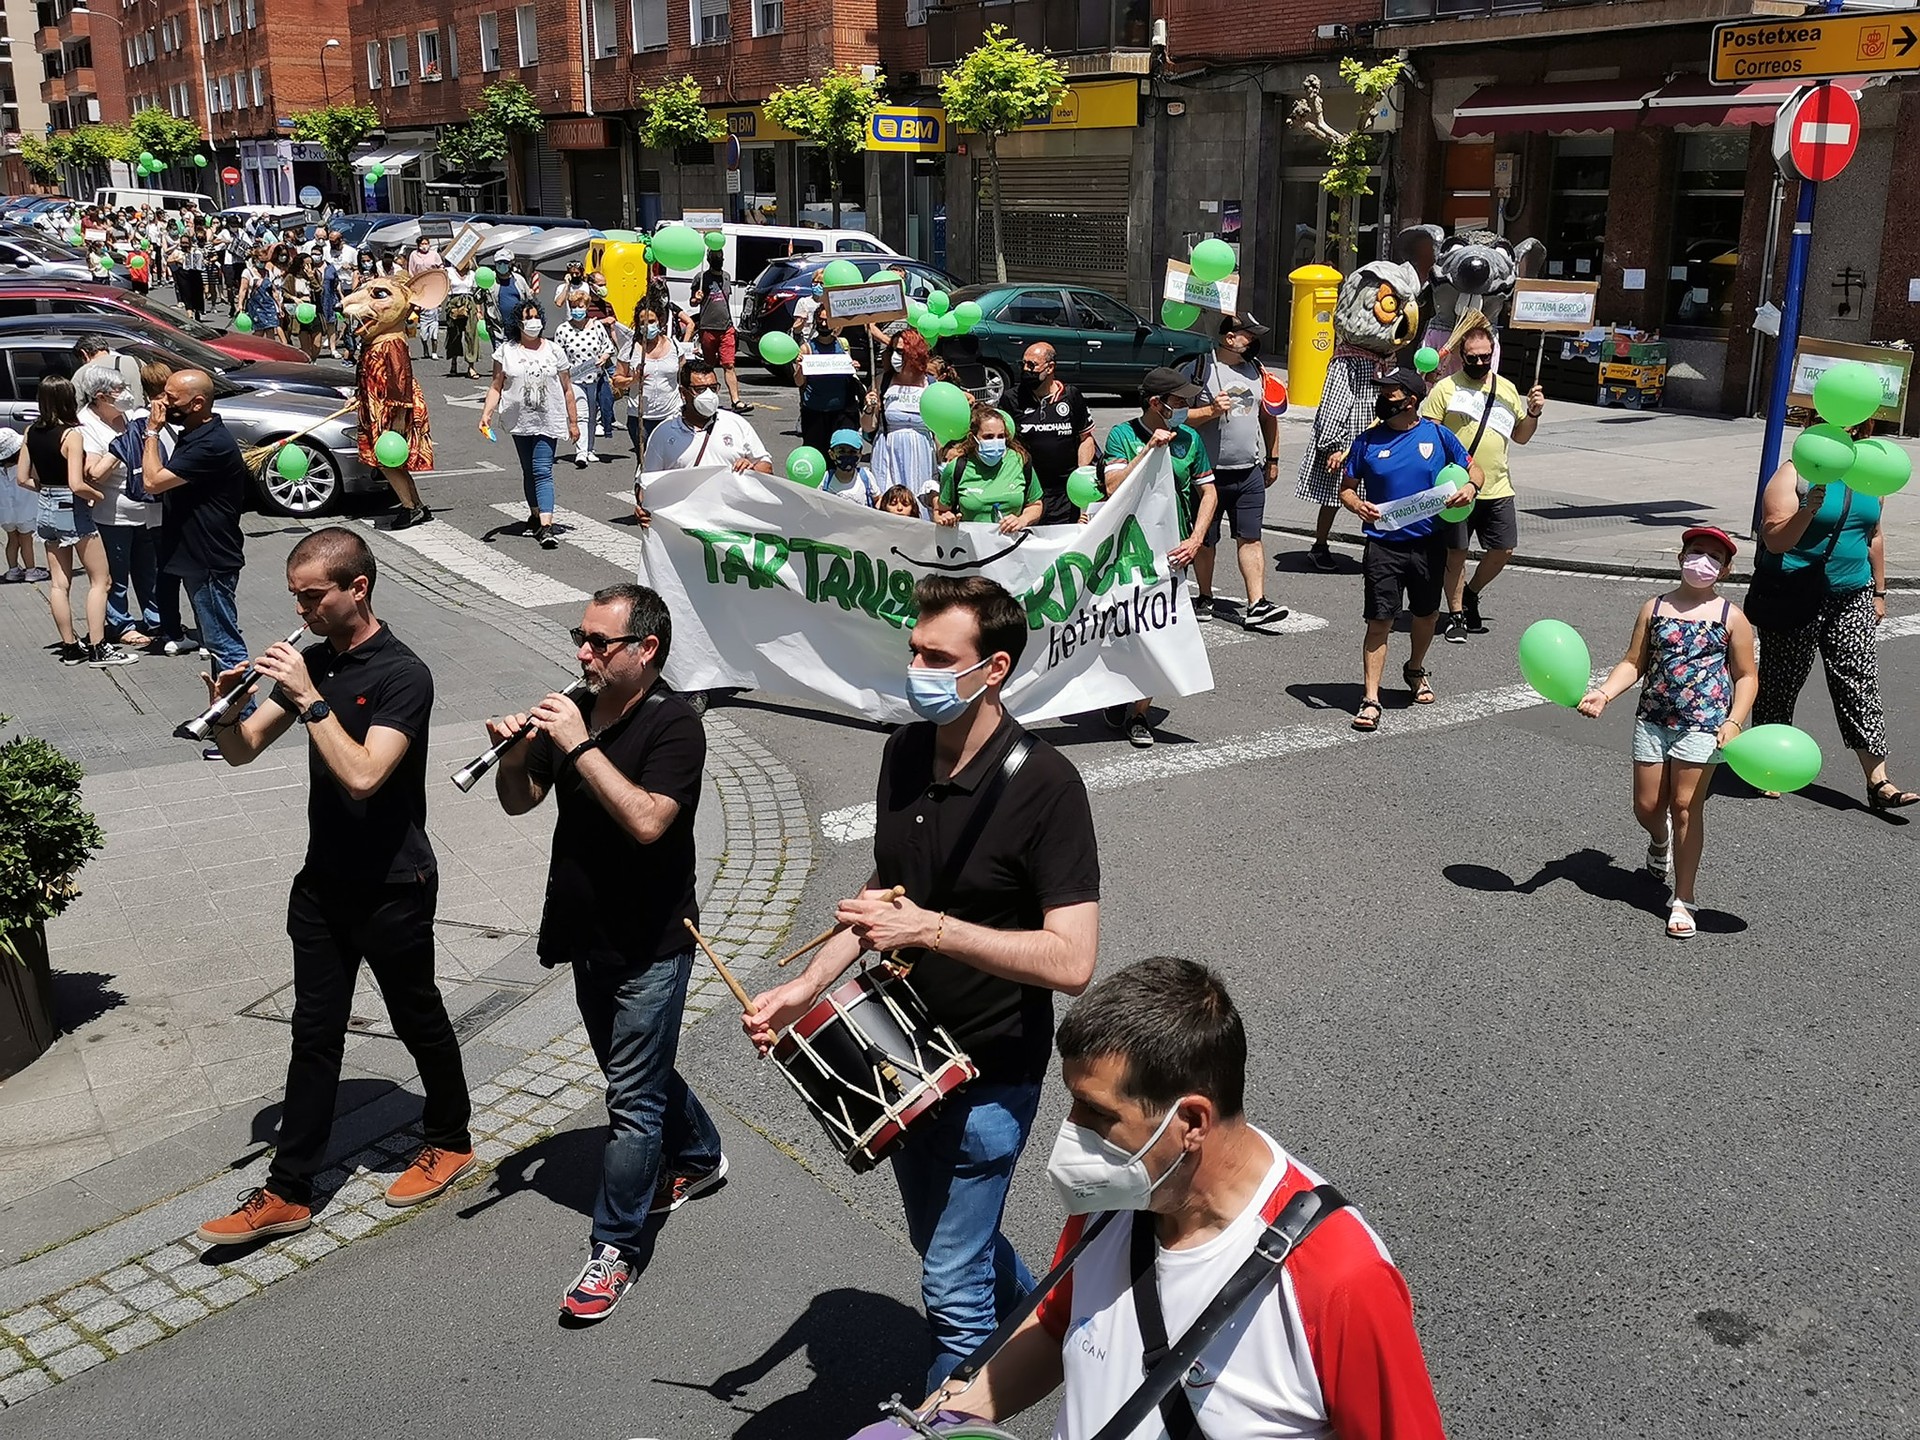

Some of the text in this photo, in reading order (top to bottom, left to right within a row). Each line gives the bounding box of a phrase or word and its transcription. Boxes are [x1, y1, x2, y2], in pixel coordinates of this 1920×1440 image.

[1722, 27, 1822, 48] Postetxea
[1734, 58, 1802, 76] Correos
[738, 112, 754, 133] BM
[1056, 108, 1074, 118] Urban
[900, 119, 934, 139] BM
[1030, 422, 1073, 432] YOKOHAMA
